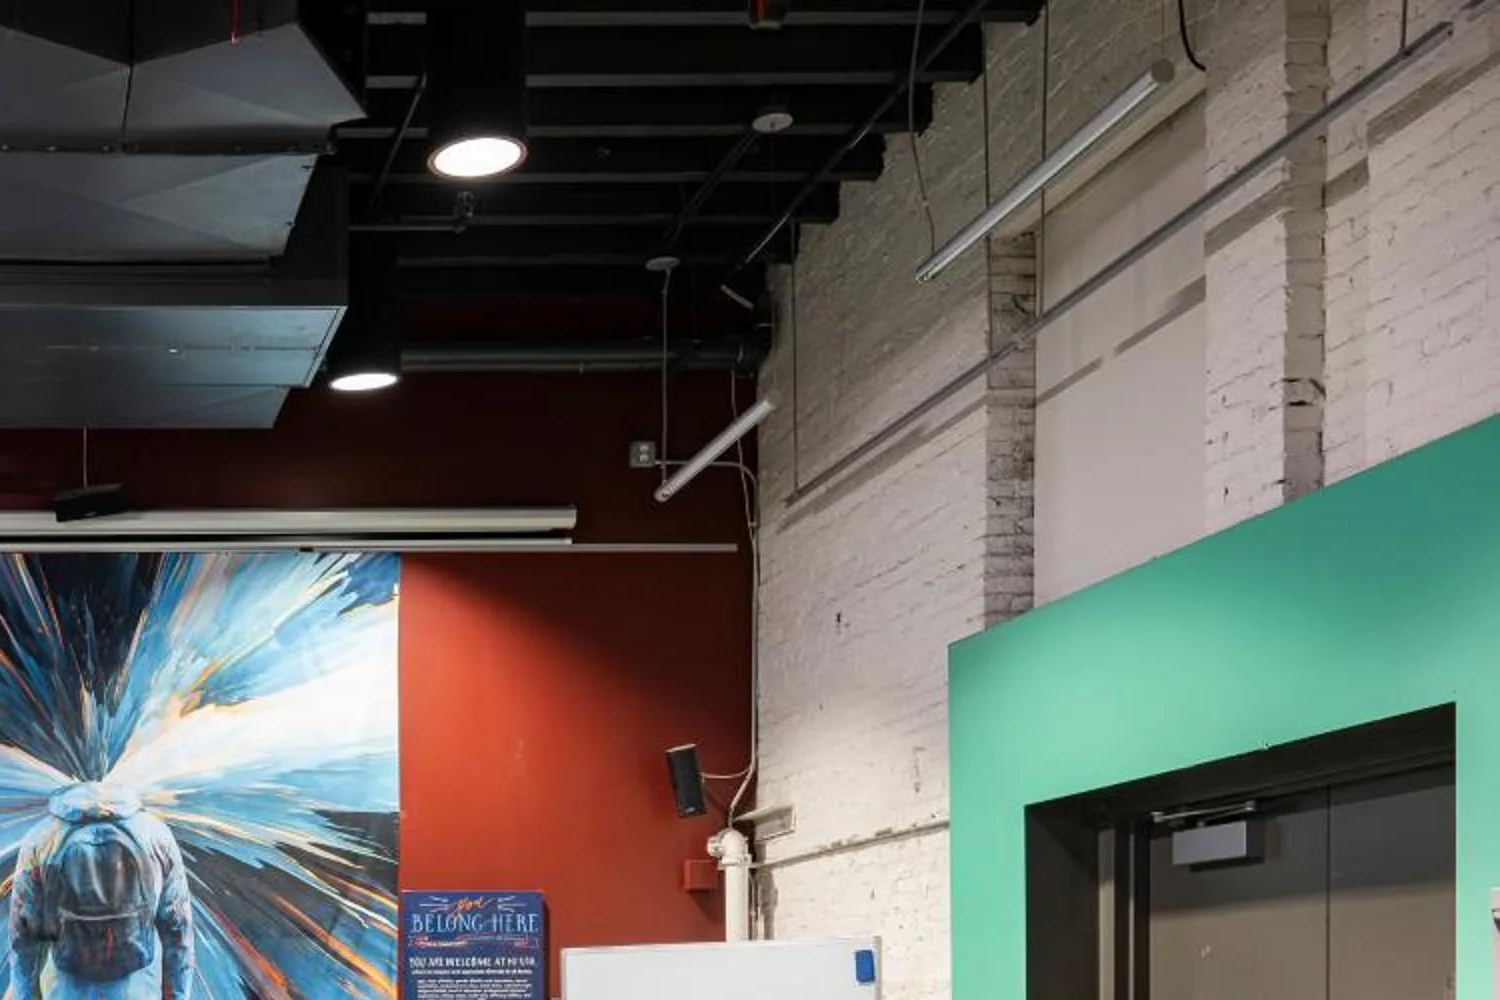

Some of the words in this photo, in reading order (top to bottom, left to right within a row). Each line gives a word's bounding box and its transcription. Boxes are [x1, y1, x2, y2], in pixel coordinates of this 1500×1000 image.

[411, 913, 483, 933] BELONG
[493, 913, 539, 933] HERE
[445, 957, 492, 967] WELCOME
[494, 957, 506, 967] AT
